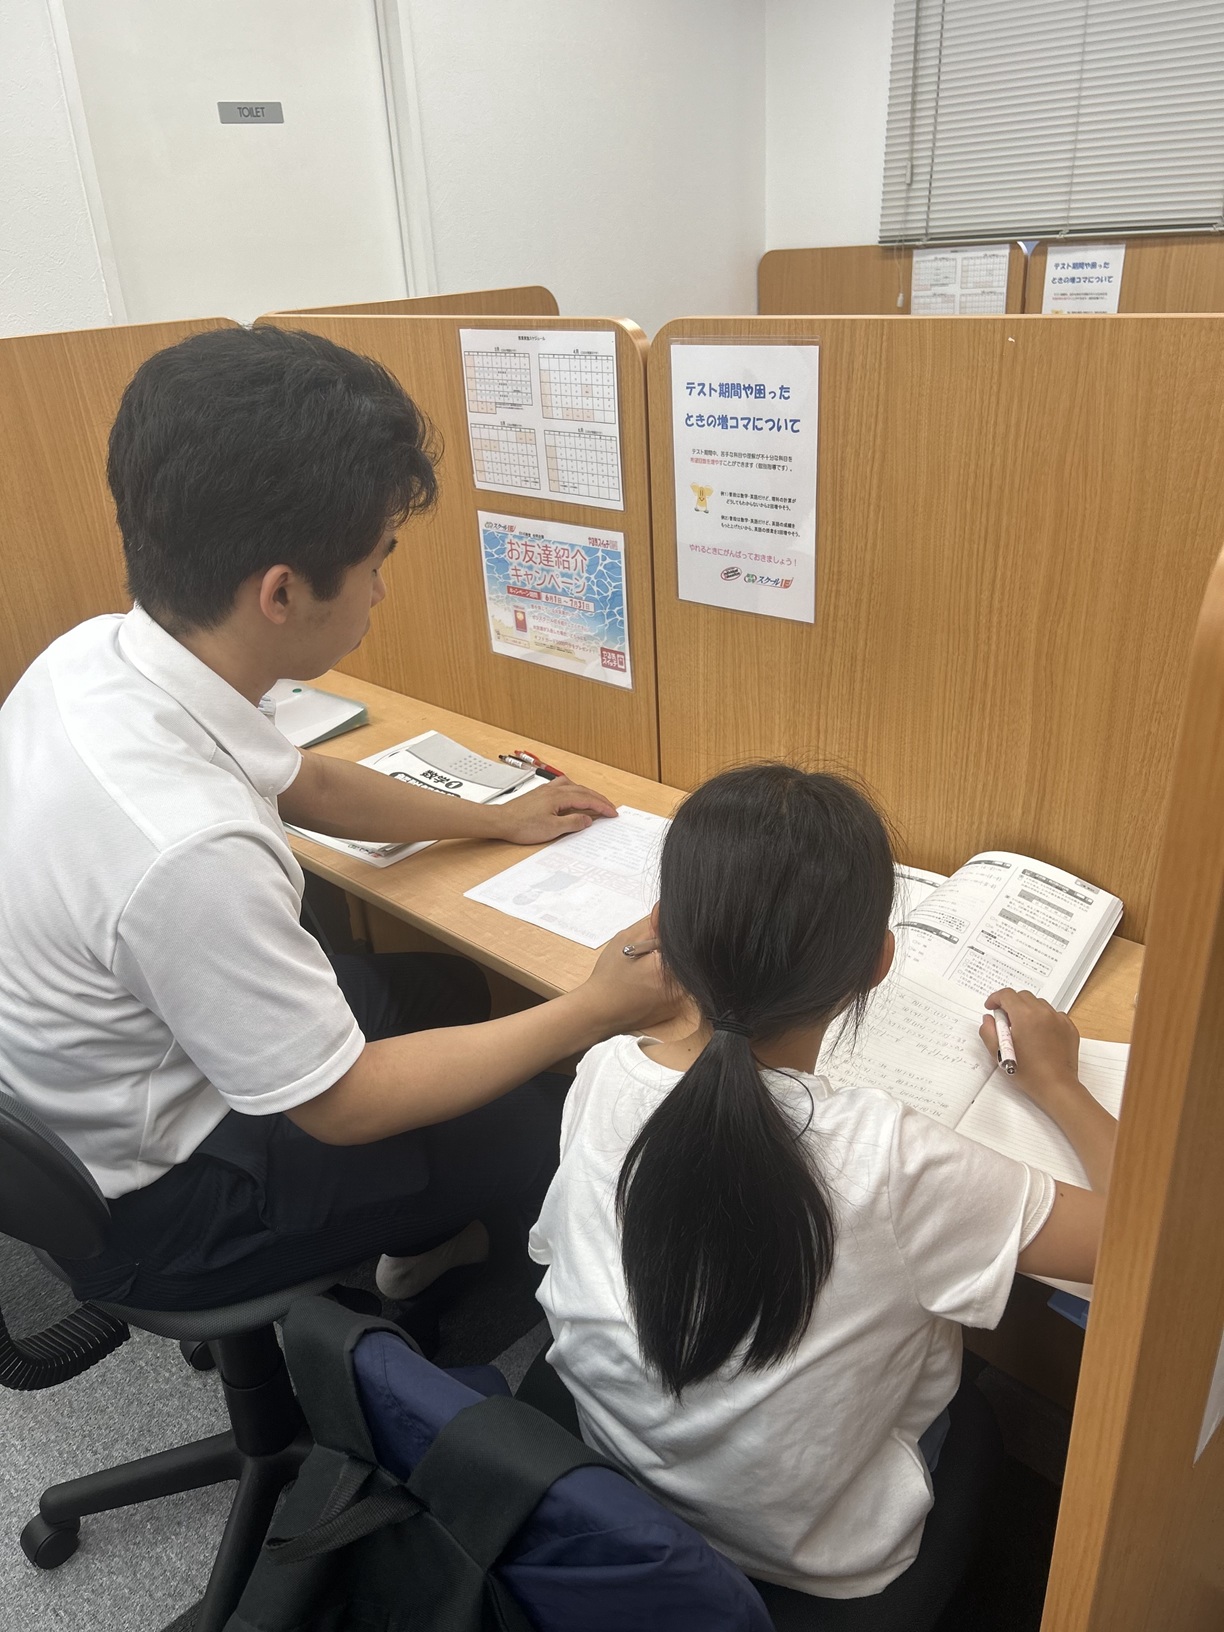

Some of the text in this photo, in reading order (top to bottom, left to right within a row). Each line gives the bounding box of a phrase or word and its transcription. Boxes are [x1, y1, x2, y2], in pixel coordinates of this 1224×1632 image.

[237, 106, 265, 118] TOILET
[685, 381, 791, 400] テスト期間や困った
[684, 413, 801, 433] ときの増コマについて
[506, 538, 588, 574] お友達紹介
[510, 565, 586, 594] キャンペーン
